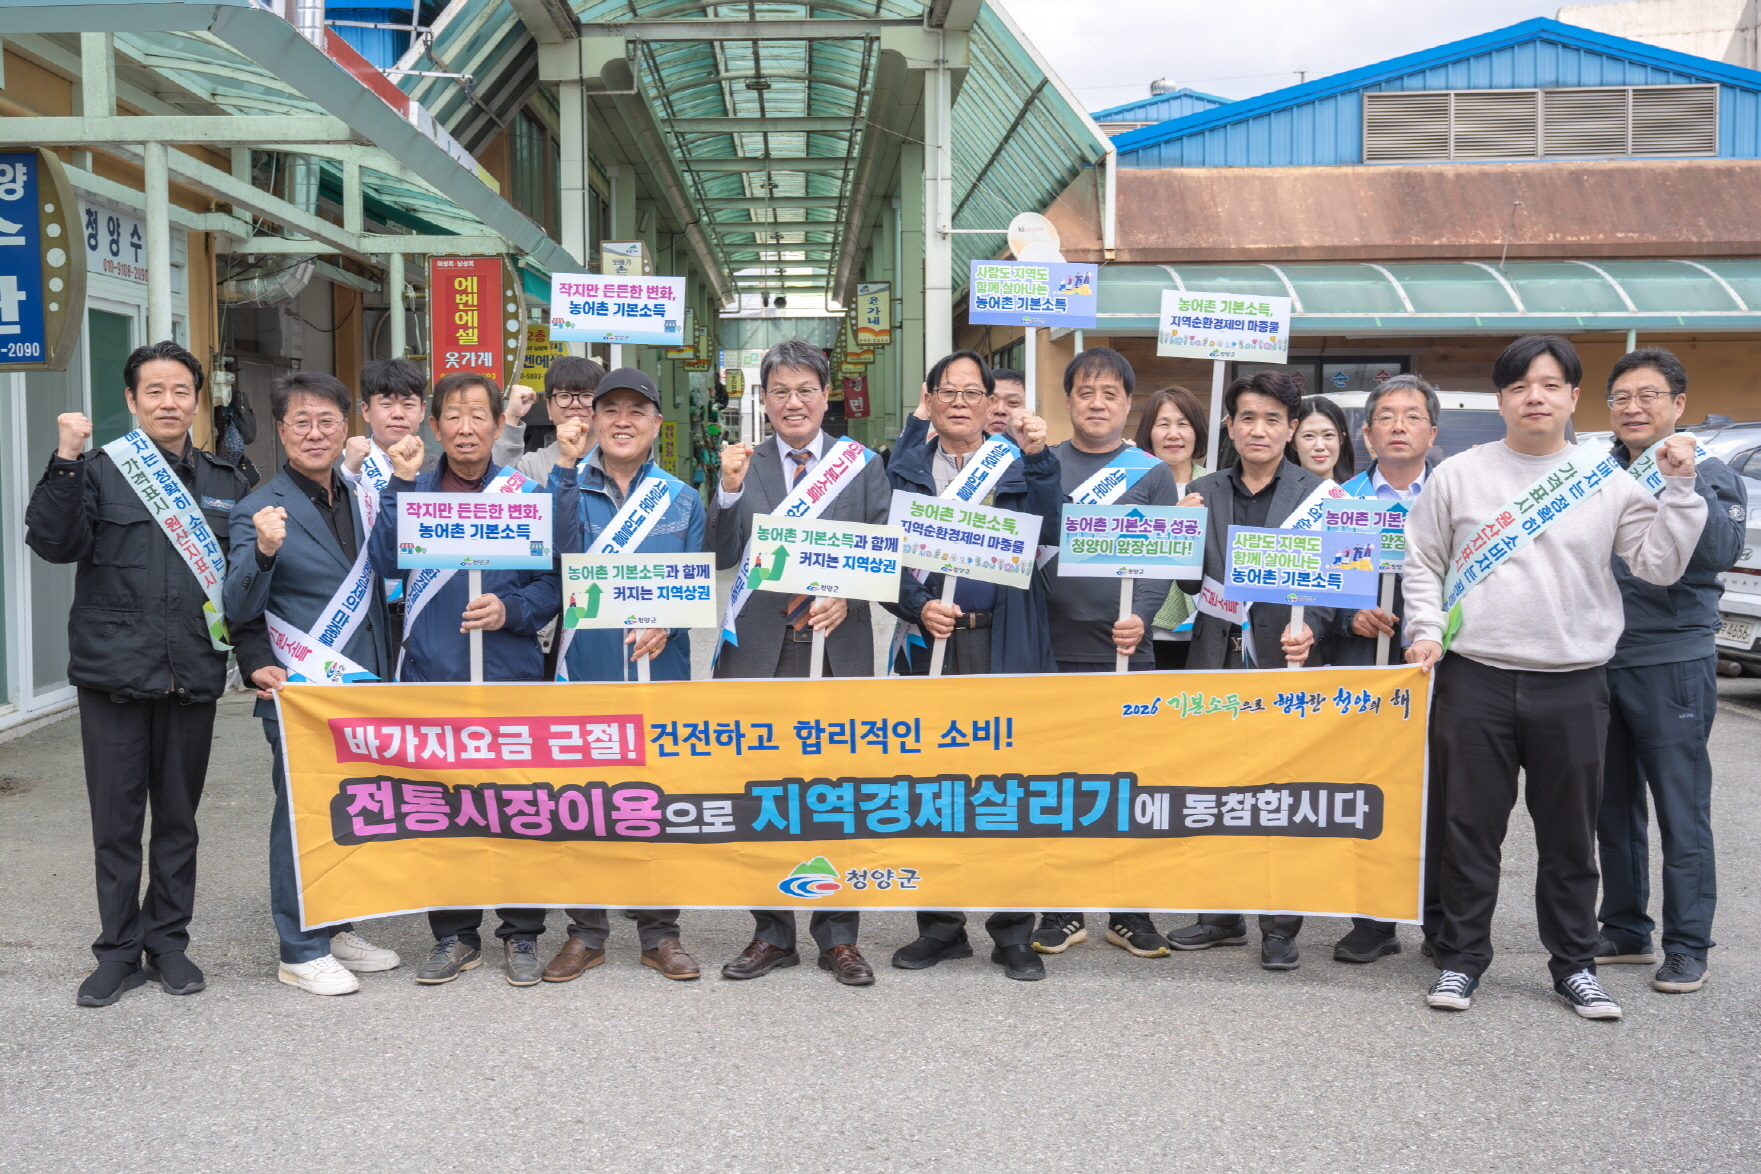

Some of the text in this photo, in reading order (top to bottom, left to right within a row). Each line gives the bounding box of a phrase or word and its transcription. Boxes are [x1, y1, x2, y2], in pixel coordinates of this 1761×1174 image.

[975, 265, 1049, 281] 사람도 지역도
[558, 283, 677, 302] 작지만 든든한 변화,
[975, 281, 1049, 297] 함께 살아나는
[453, 276, 479, 345] 에벤에셀
[568, 301, 666, 318] 농어촌 기본소득
[975, 296, 1068, 313] 농어촌 기본소득
[1178, 297, 1275, 318] 농어촌 기본소득,
[1170, 315, 1280, 334] 지역순환경제의 마중물
[444, 352, 493, 369] 옷가게
[805, 458, 850, 505] 기본소득
[956, 443, 1012, 502] 새로운 내일을
[1092, 469, 1129, 500] 새로운
[639, 480, 670, 514] 새로운
[152, 468, 192, 511] 정확히
[188, 515, 226, 572] 소비자는
[406, 502, 543, 521] 작지만 든든한 변화,
[909, 500, 1020, 536] 농어촌 기본소득,
[1325, 510, 1370, 527] 농어촌
[1373, 512, 1406, 528] 기본
[1454, 461, 1579, 573] 가격표시 원산지표시
[1521, 494, 1570, 537] 정확히
[121, 458, 171, 515] 가격표시
[163, 515, 218, 589] 원산지표시
[418, 523, 532, 540] 농어촌 기본소득
[611, 509, 647, 548] 내일을
[1065, 516, 1202, 536] 농어촌 기본소득 성공,
[757, 525, 899, 553] 농어촌 기본소득과 함께
[900, 520, 986, 547] 지역순환경제의
[987, 535, 1025, 554] 마중물
[1071, 538, 1193, 556] 청양이 앞장섭니다!
[1233, 533, 1321, 552] 사람도 지역도
[799, 551, 840, 569] 커지는
[842, 555, 897, 574] 지역상권
[1232, 551, 1321, 570] 함께 살아나는
[1463, 533, 1517, 584] 소비자는
[567, 564, 711, 580] 농어촌 기본소득과 함께
[1231, 568, 1343, 590] 농어촌 기본소득
[613, 585, 711, 601] 커지는 지역상권
[1122, 687, 1410, 720] 2026 기본소득으로 행복한 청양의 해
[343, 716, 1014, 763] 바가지요금 근절! 건전하고 합리적인 소비!
[345, 778, 1370, 838] 전통시장이용으로 지역경제살리기에 동참합시다
[845, 868, 922, 891] 청양군
